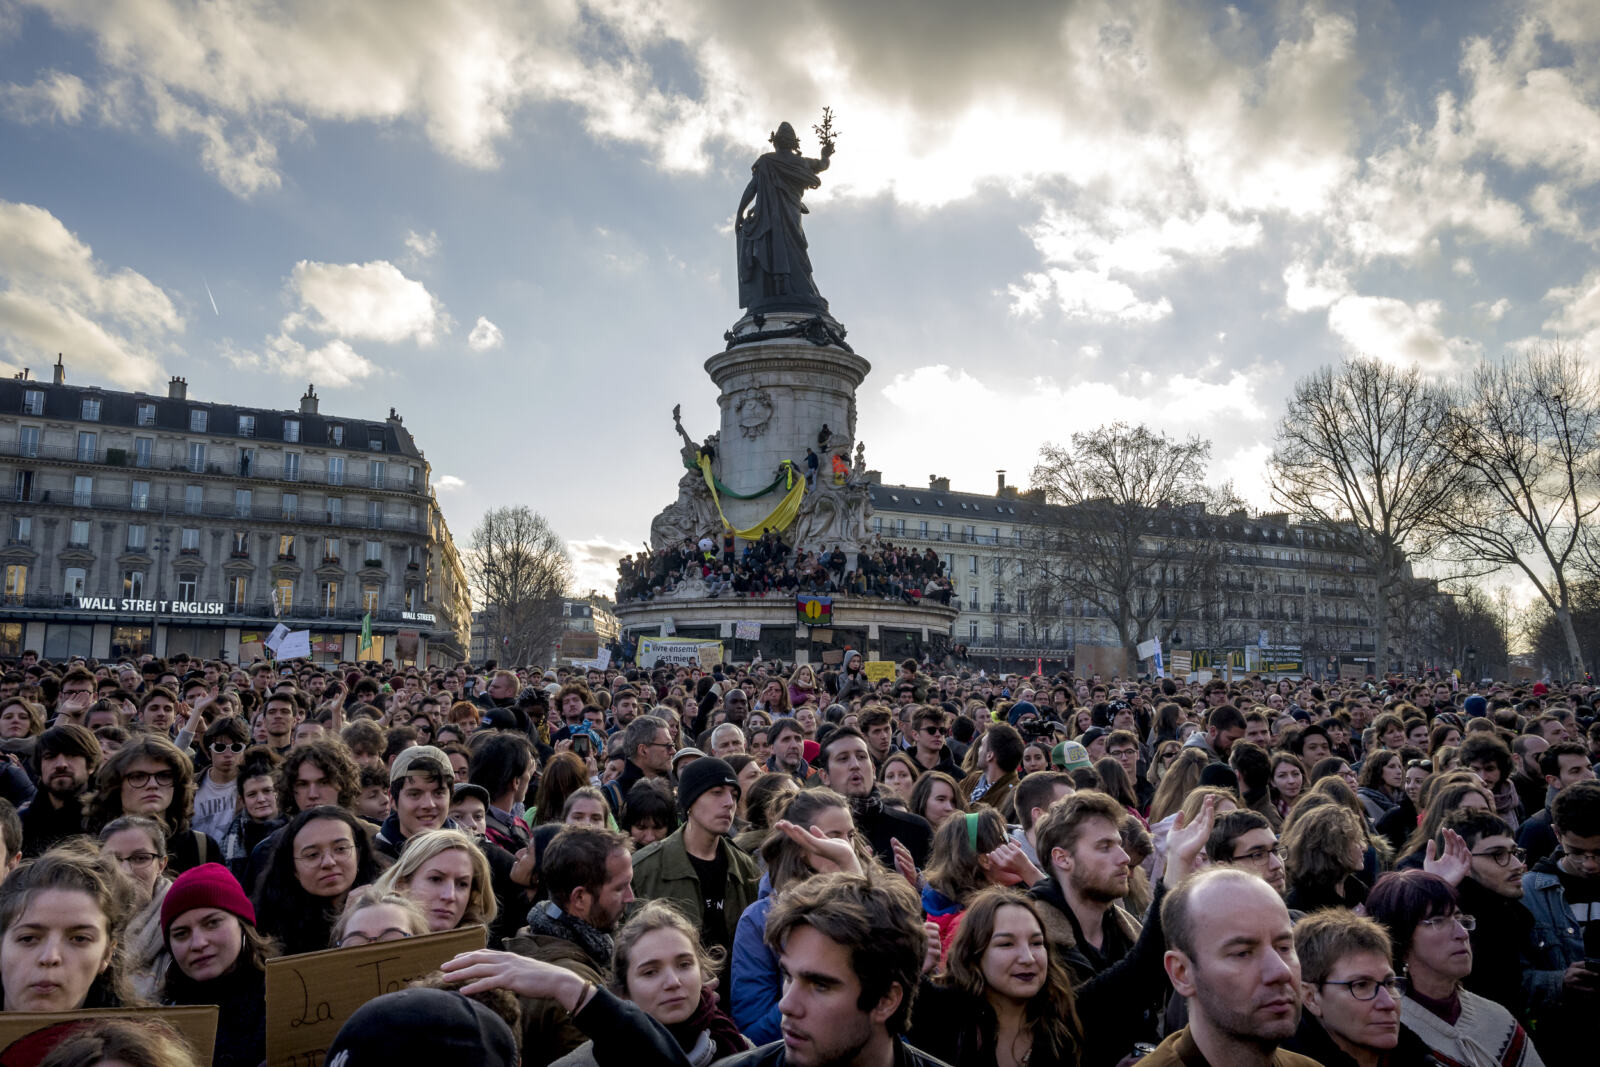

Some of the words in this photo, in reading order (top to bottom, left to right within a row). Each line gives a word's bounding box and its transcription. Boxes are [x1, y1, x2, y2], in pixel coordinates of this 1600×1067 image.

[79, 597, 116, 610] WALL
[171, 601, 224, 614] ENGLISH
[402, 611, 416, 620] WALL
[669, 644, 700, 653] ensemb
[290, 968, 334, 1028] La
